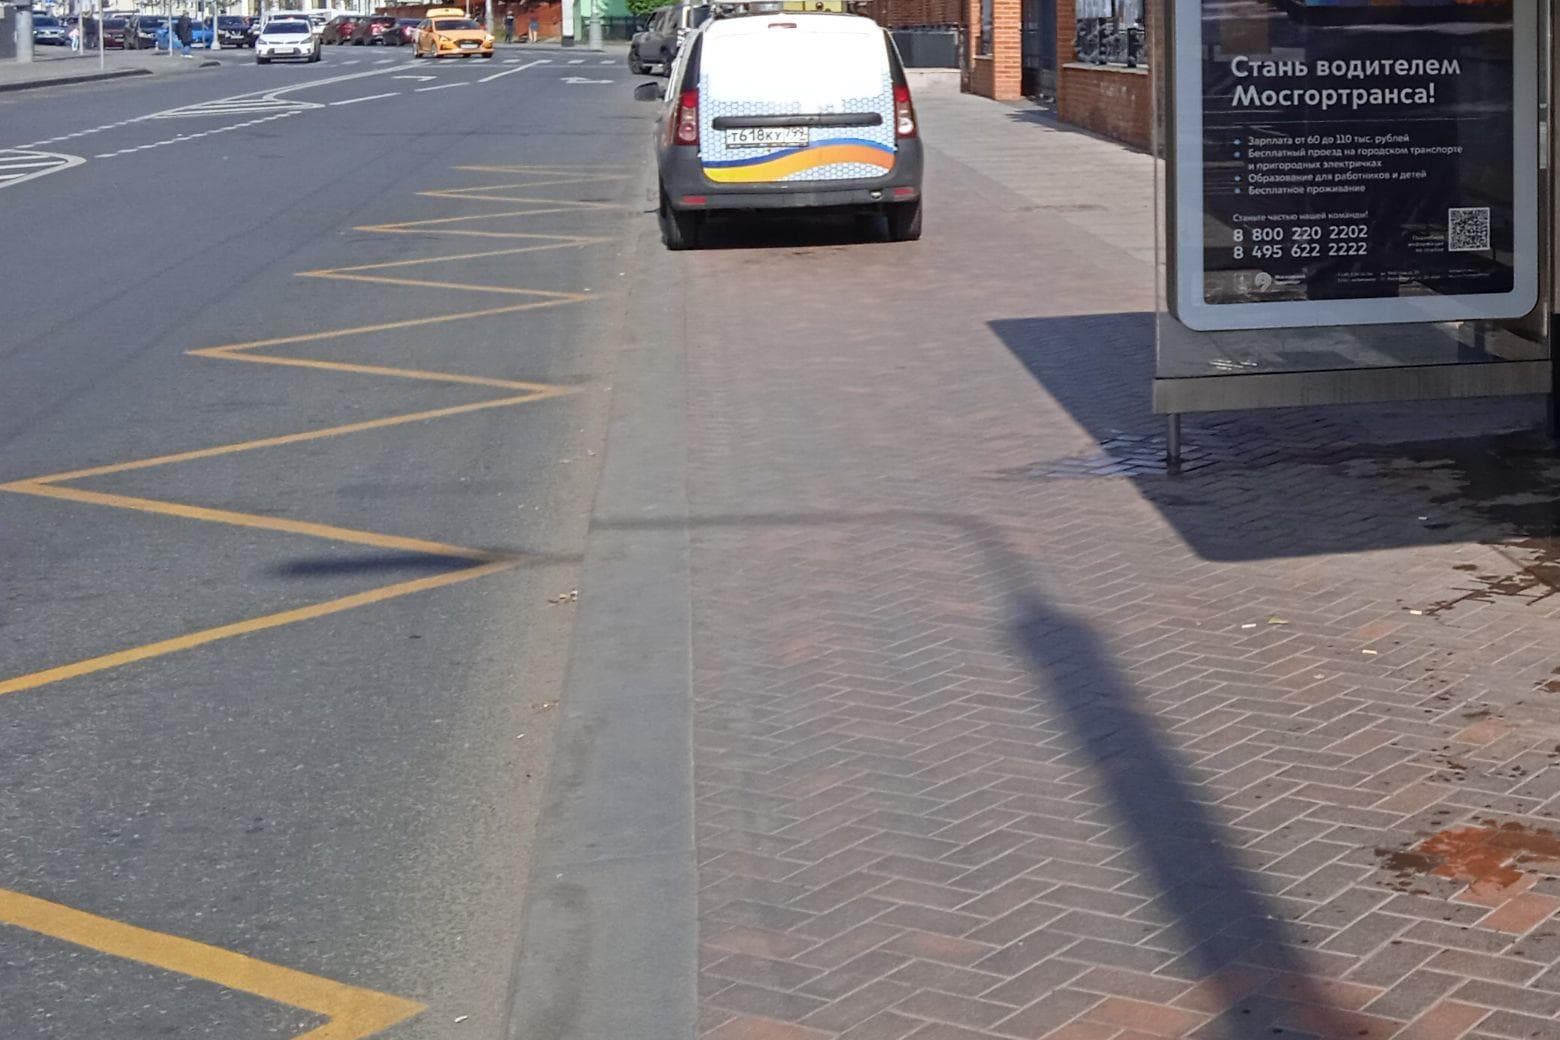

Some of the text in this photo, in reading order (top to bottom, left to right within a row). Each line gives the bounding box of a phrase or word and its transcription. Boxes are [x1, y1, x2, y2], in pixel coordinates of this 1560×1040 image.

[1231, 56, 1461, 79] Стань водителем
[1231, 82, 1436, 110] Мосгортранса!
[1248, 136, 1293, 147] Зарплата
[1307, 135, 1321, 144] 60
[1322, 137, 1335, 145] до
[1336, 134, 1352, 144] 110
[1354, 135, 1374, 143] тыс.
[1375, 133, 1410, 144] рублей
[1248, 148, 1306, 158] Бесплатный
[1308, 148, 1343, 158] проезд
[1358, 147, 1409, 157] городском
[1410, 146, 1464, 156] транспорте
[1256, 161, 1321, 171] пригородных
[1323, 160, 1382, 169] электричках
[1248, 173, 1314, 184] Образование
[1315, 173, 1333, 182] для
[1334, 171, 1391, 182] работников
[1399, 170, 1427, 180] детей
[1248, 185, 1366, 195] Бесплатное проживание
[1233, 225, 1368, 242] 8 800 220 2202
[1233, 242, 1368, 259] 8 495 622 2222
